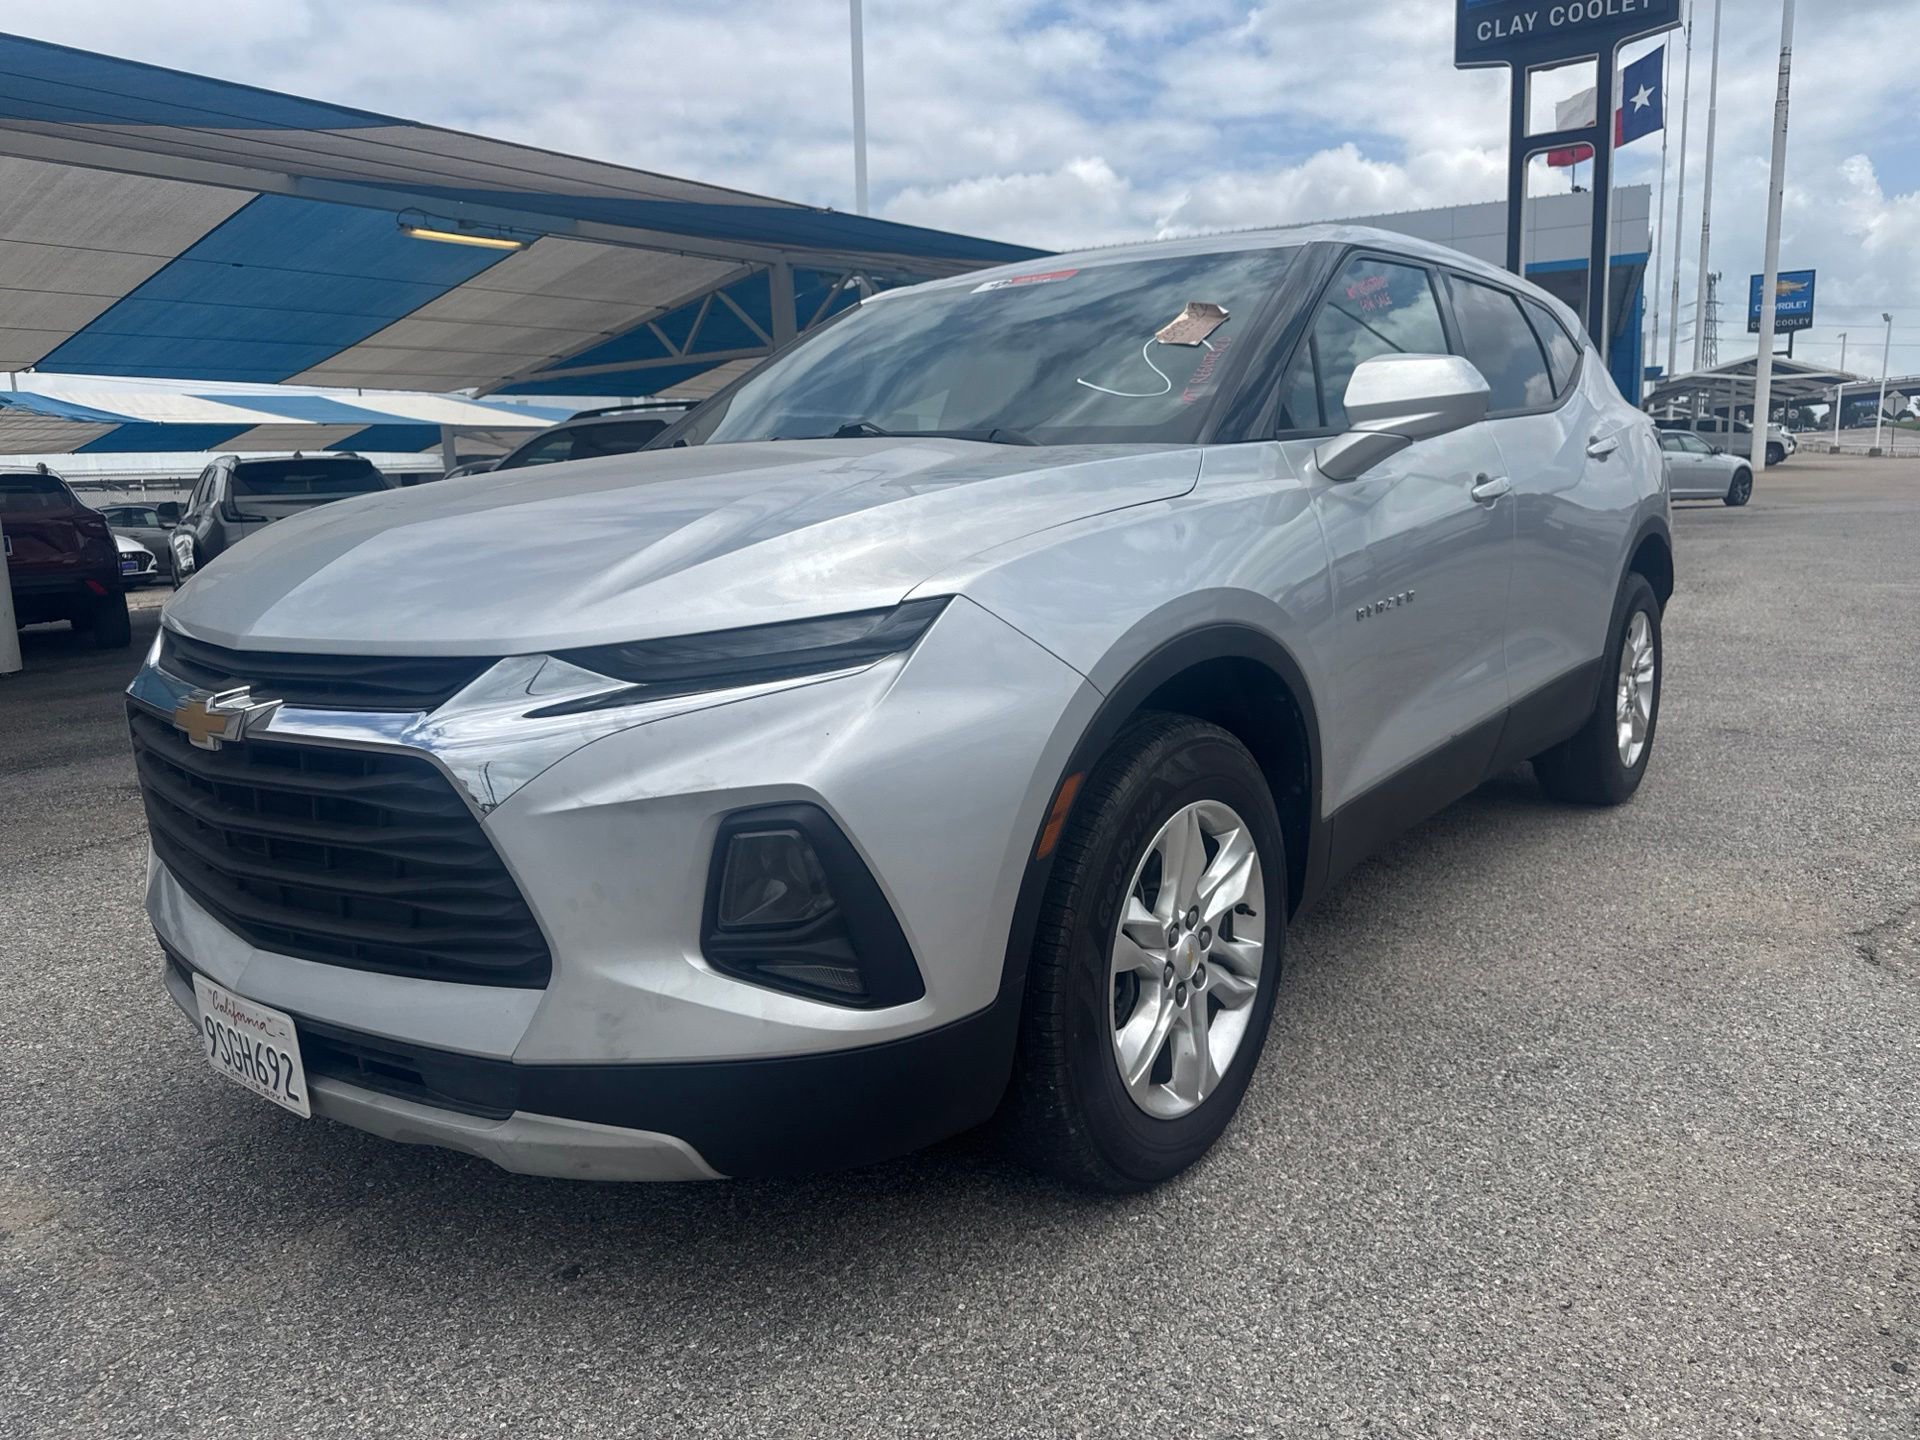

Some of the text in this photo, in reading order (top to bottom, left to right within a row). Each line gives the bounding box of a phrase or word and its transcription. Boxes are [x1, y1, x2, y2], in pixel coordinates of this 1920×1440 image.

[1477, 11, 1538, 41] CLAY
[1754, 301, 1808, 312] CVROLET
[1775, 317, 1810, 327] COOLEY
[1356, 589, 1416, 622] BLAZER
[212, 990, 276, 1037] California
[204, 1015, 300, 1101] 9SGH692
